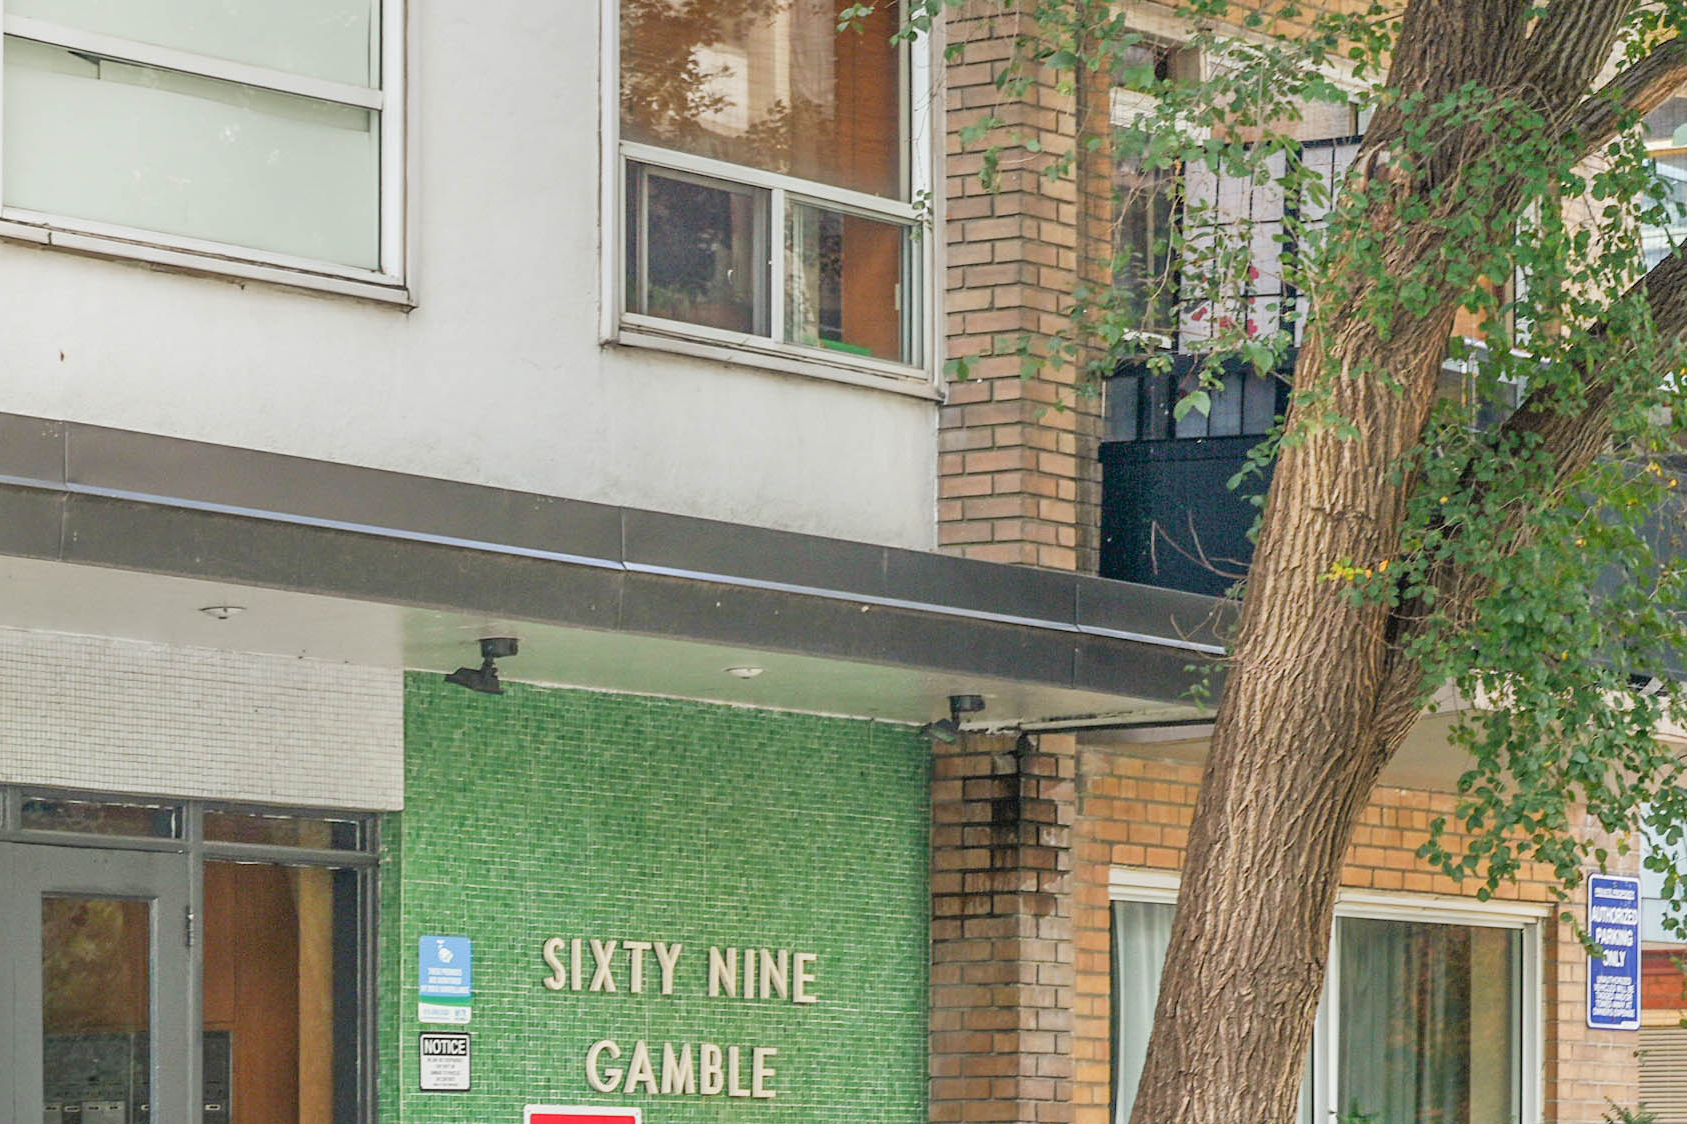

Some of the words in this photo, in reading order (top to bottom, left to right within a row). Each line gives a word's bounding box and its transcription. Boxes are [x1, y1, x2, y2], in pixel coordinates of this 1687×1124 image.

[1595, 927, 1633, 947] PARKING
[1602, 949, 1626, 967] ONLY
[542, 937, 683, 995] SIXTY
[708, 946, 818, 1003] NINE
[424, 1038, 466, 1055] NOTICE
[585, 1039, 778, 1098] GAMBLE
